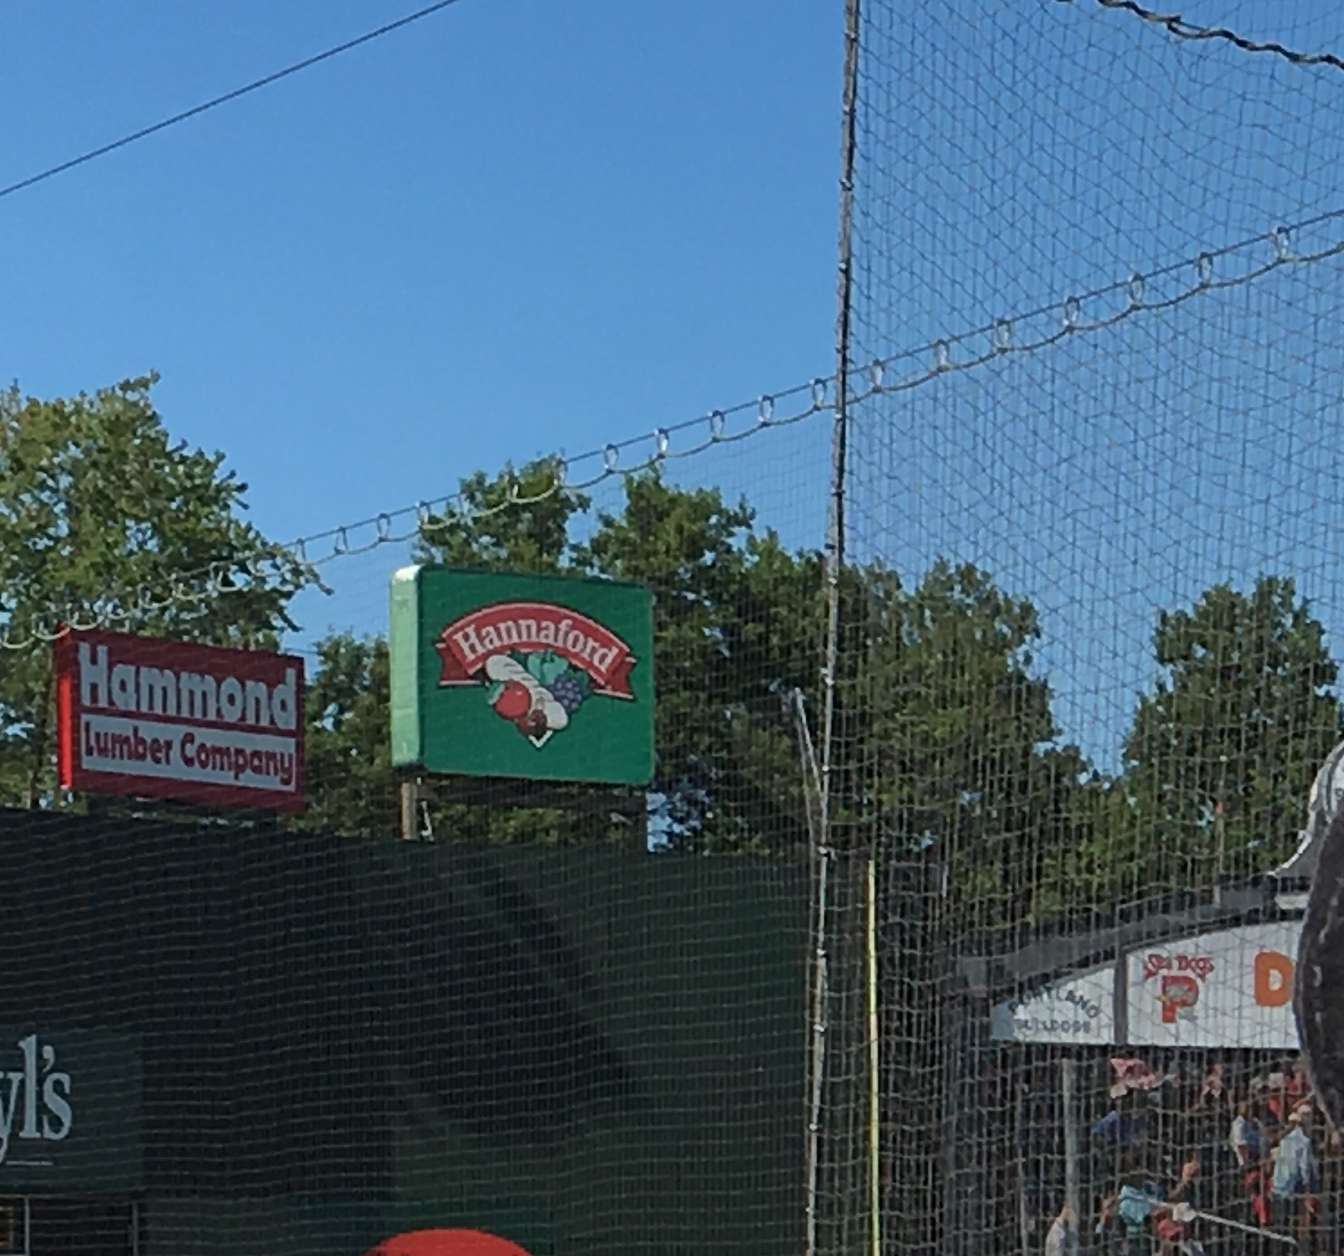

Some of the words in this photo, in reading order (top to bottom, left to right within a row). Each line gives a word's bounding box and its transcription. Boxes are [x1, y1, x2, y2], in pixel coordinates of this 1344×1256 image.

[453, 619, 620, 673] Hannaford
[78, 641, 296, 731] Hammond
[85, 721, 173, 765] Lumber
[180, 732, 294, 786] Company
